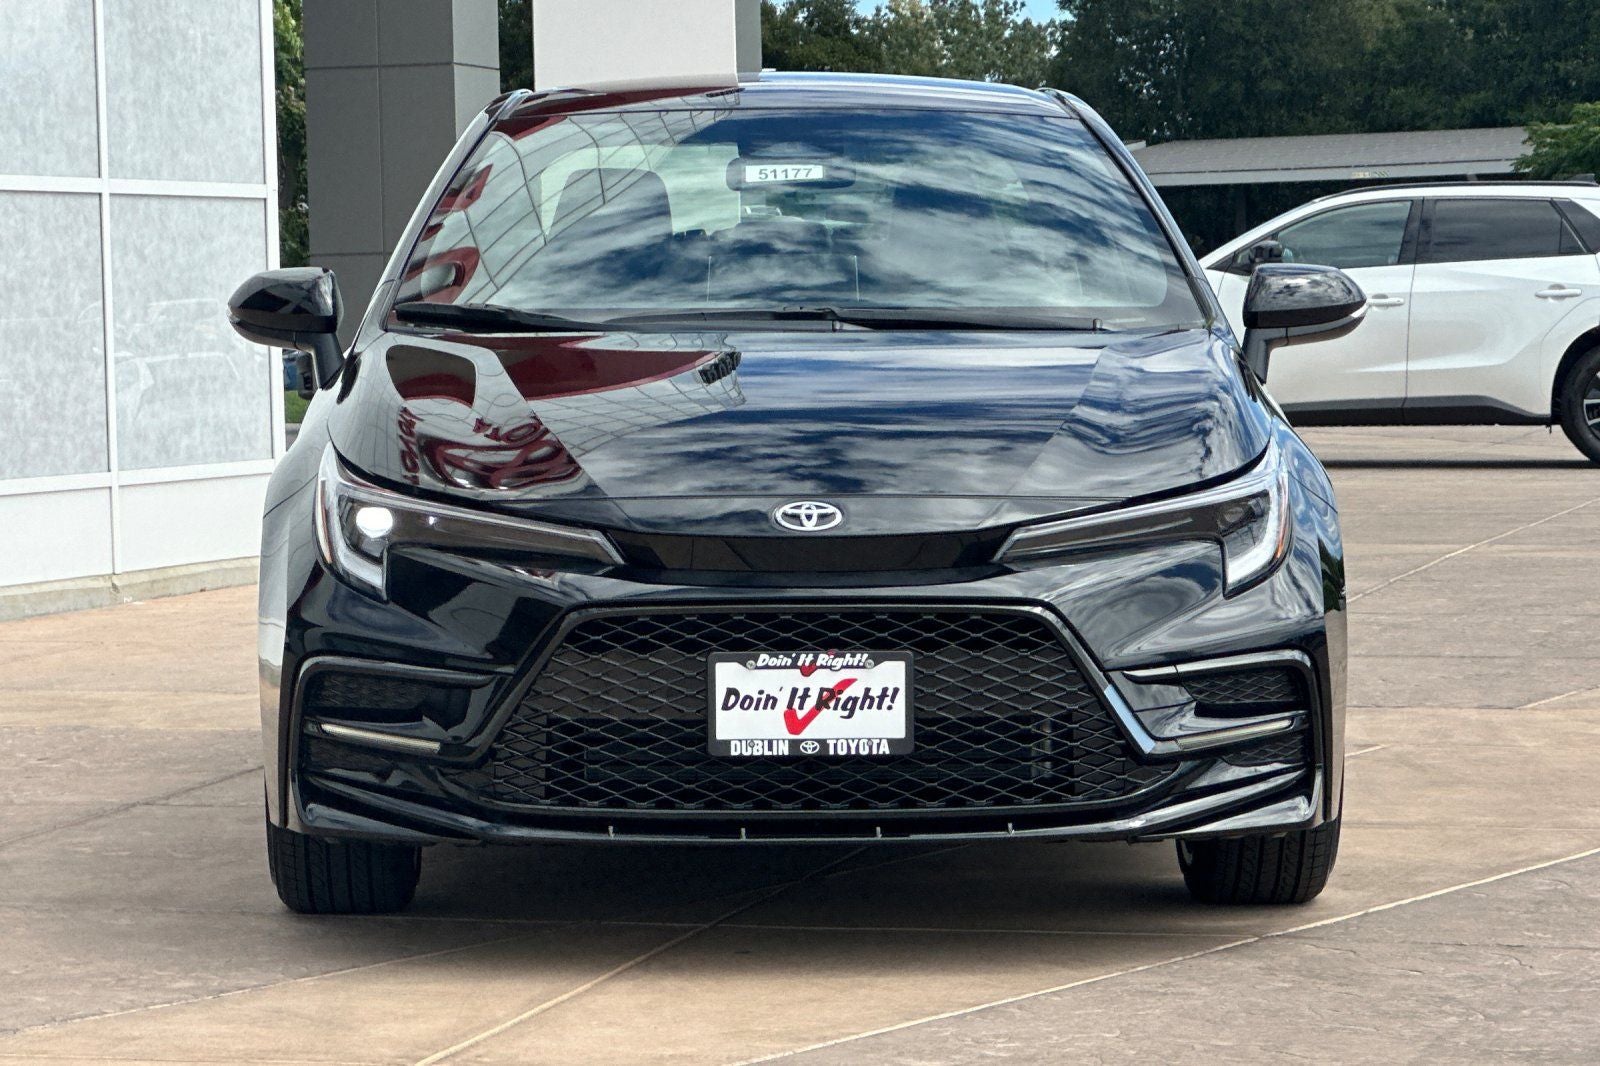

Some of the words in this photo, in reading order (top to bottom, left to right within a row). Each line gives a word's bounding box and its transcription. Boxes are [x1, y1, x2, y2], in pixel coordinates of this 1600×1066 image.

[758, 168, 813, 180] 51177
[756, 653, 796, 667] Doin'
[797, 653, 811, 666] It
[815, 653, 869, 670] Right!
[721, 686, 783, 711] Doin'
[786, 686, 811, 711] It
[815, 686, 900, 719] Right!
[730, 739, 789, 756] DUBLIN
[826, 739, 890, 755] TOYOTA
